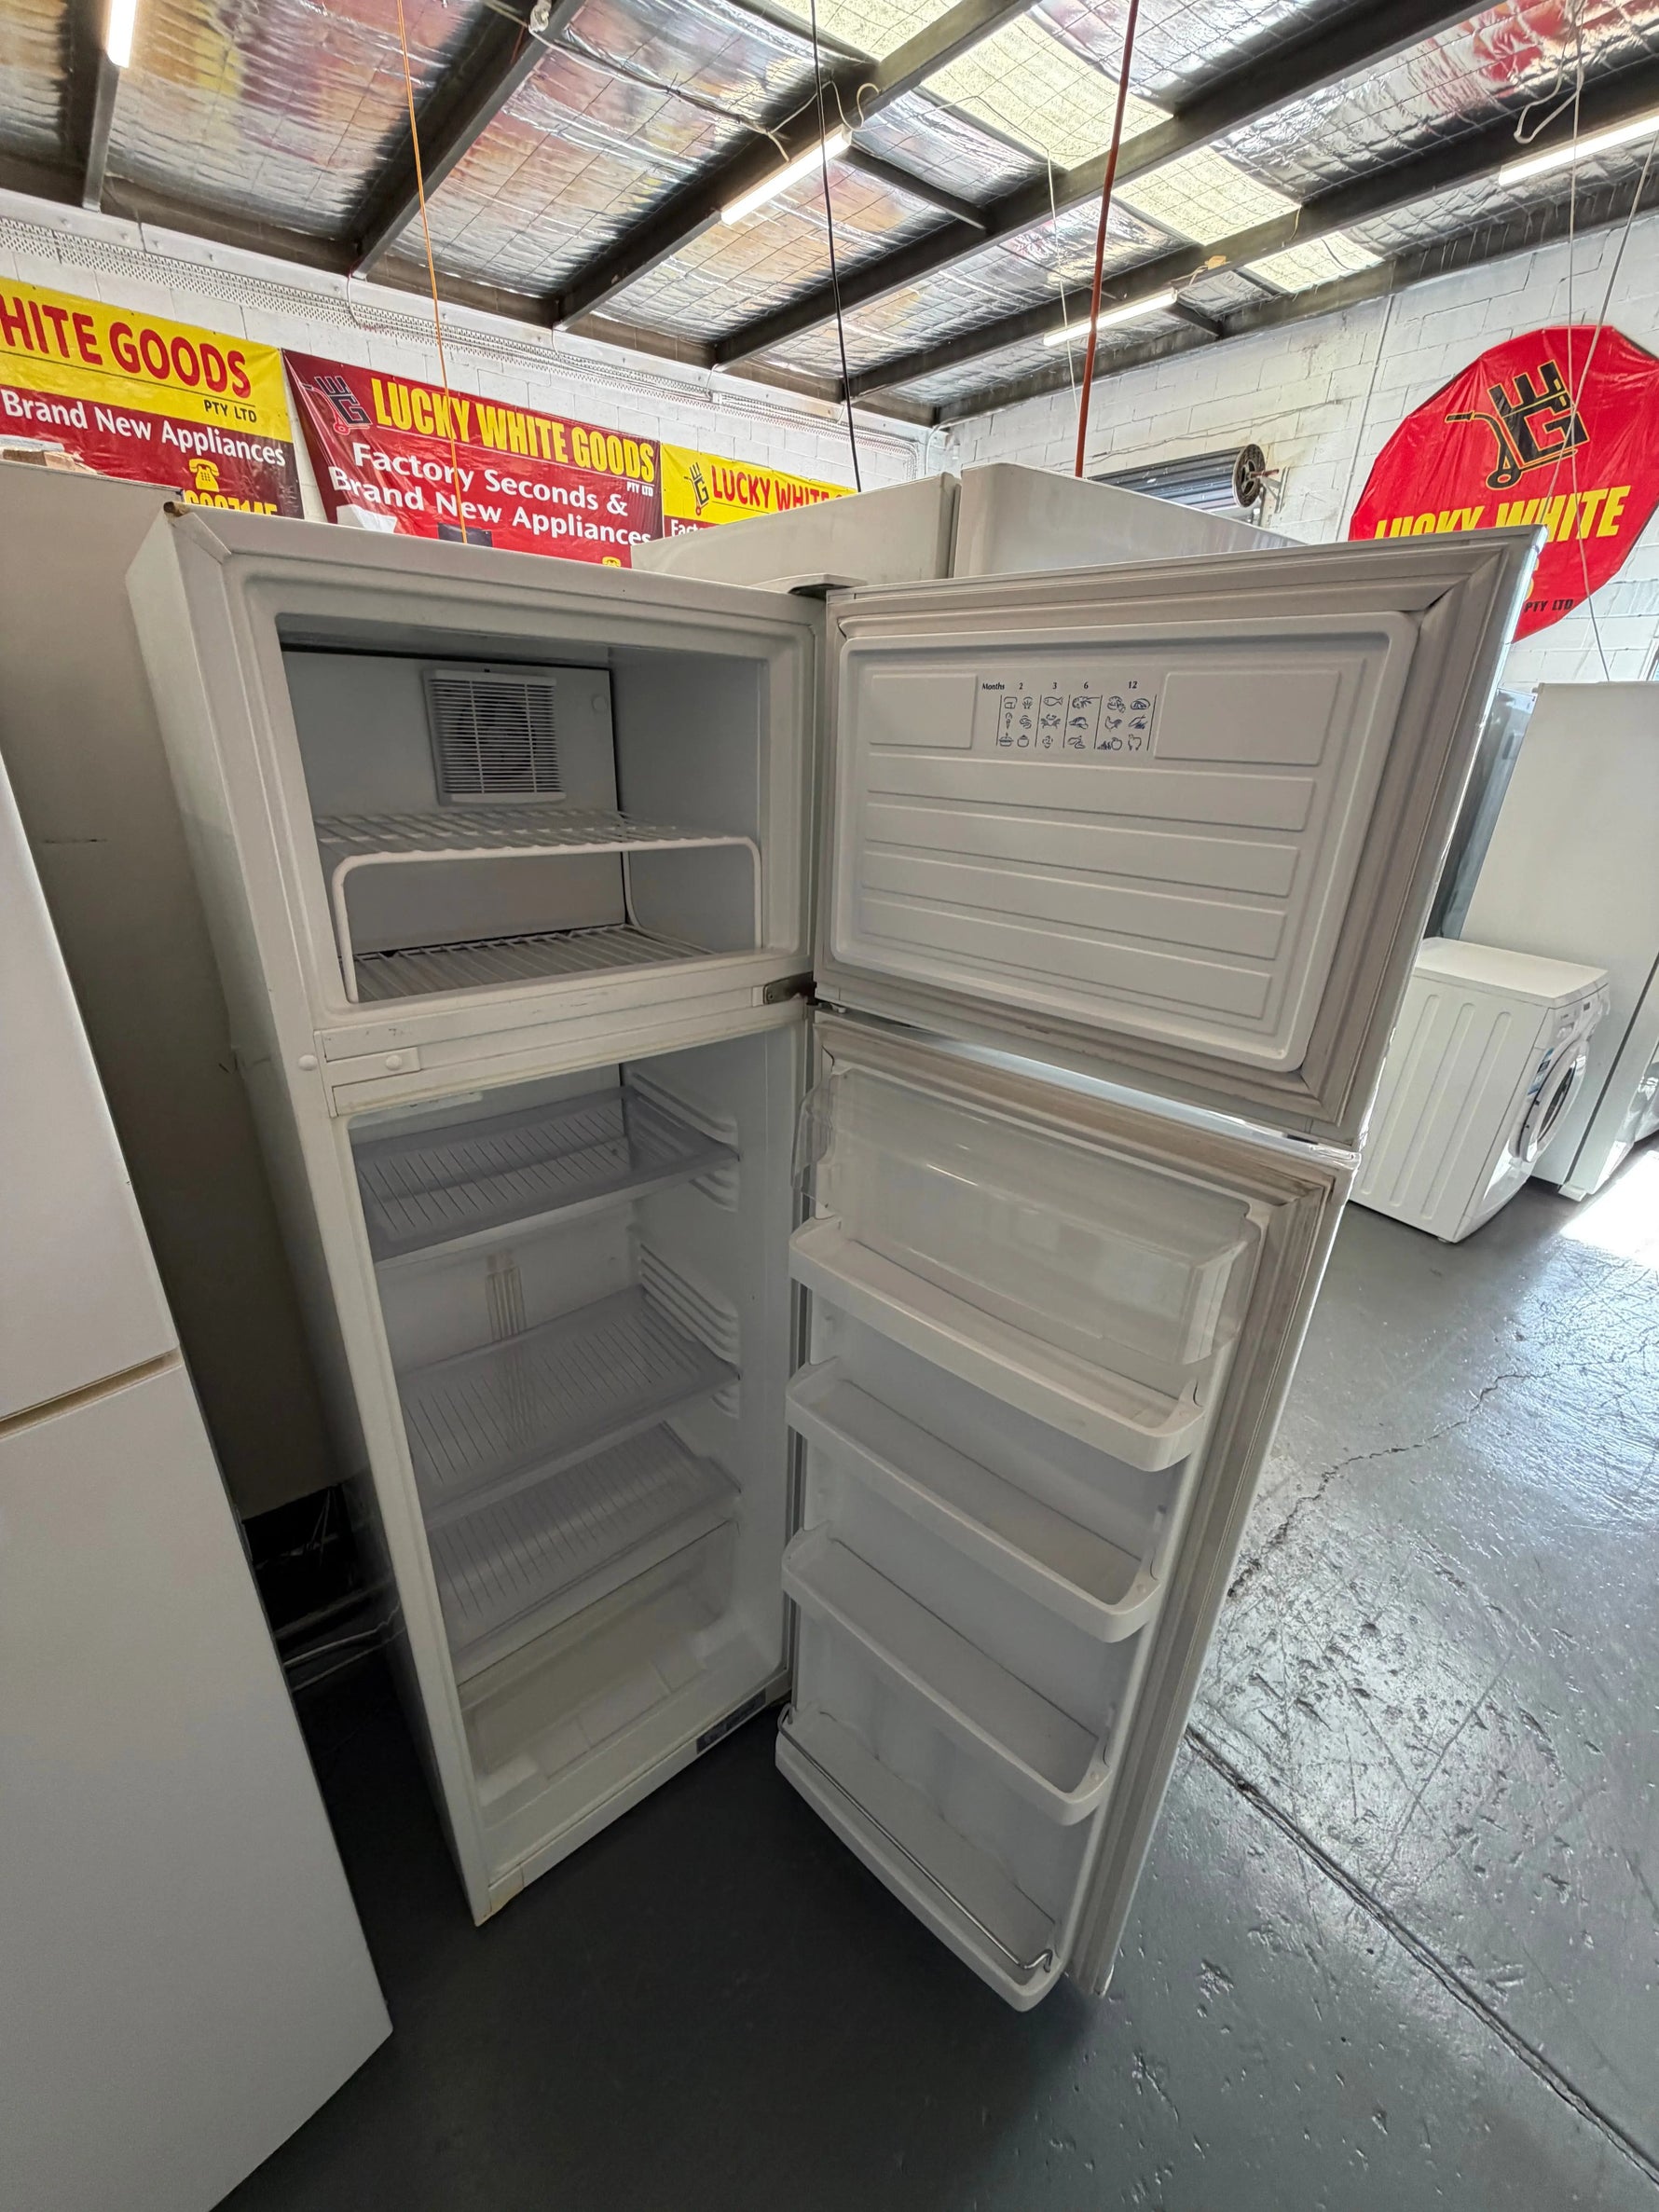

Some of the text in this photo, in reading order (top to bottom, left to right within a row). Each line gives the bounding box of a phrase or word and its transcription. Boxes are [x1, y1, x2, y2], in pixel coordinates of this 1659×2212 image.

[109, 322, 252, 398] GOODS
[1, 390, 286, 467] Brand New Appliances
[203, 400, 257, 422] PTY LTD
[371, 378, 655, 484] LUCKY WHITE GOODS
[328, 466, 652, 546] Brand New Appliances
[352, 442, 629, 517] Factory Seconds &
[626, 481, 654, 497] PTY LTD
[711, 464, 772, 509] LUCKY
[1495, 485, 1631, 543] WHITE
[1524, 598, 1573, 613] PTY LTD
[981, 681, 1006, 691] Months
[1052, 681, 1058, 690] 3
[1083, 680, 1090, 690] 6
[1129, 680, 1138, 689] 12
